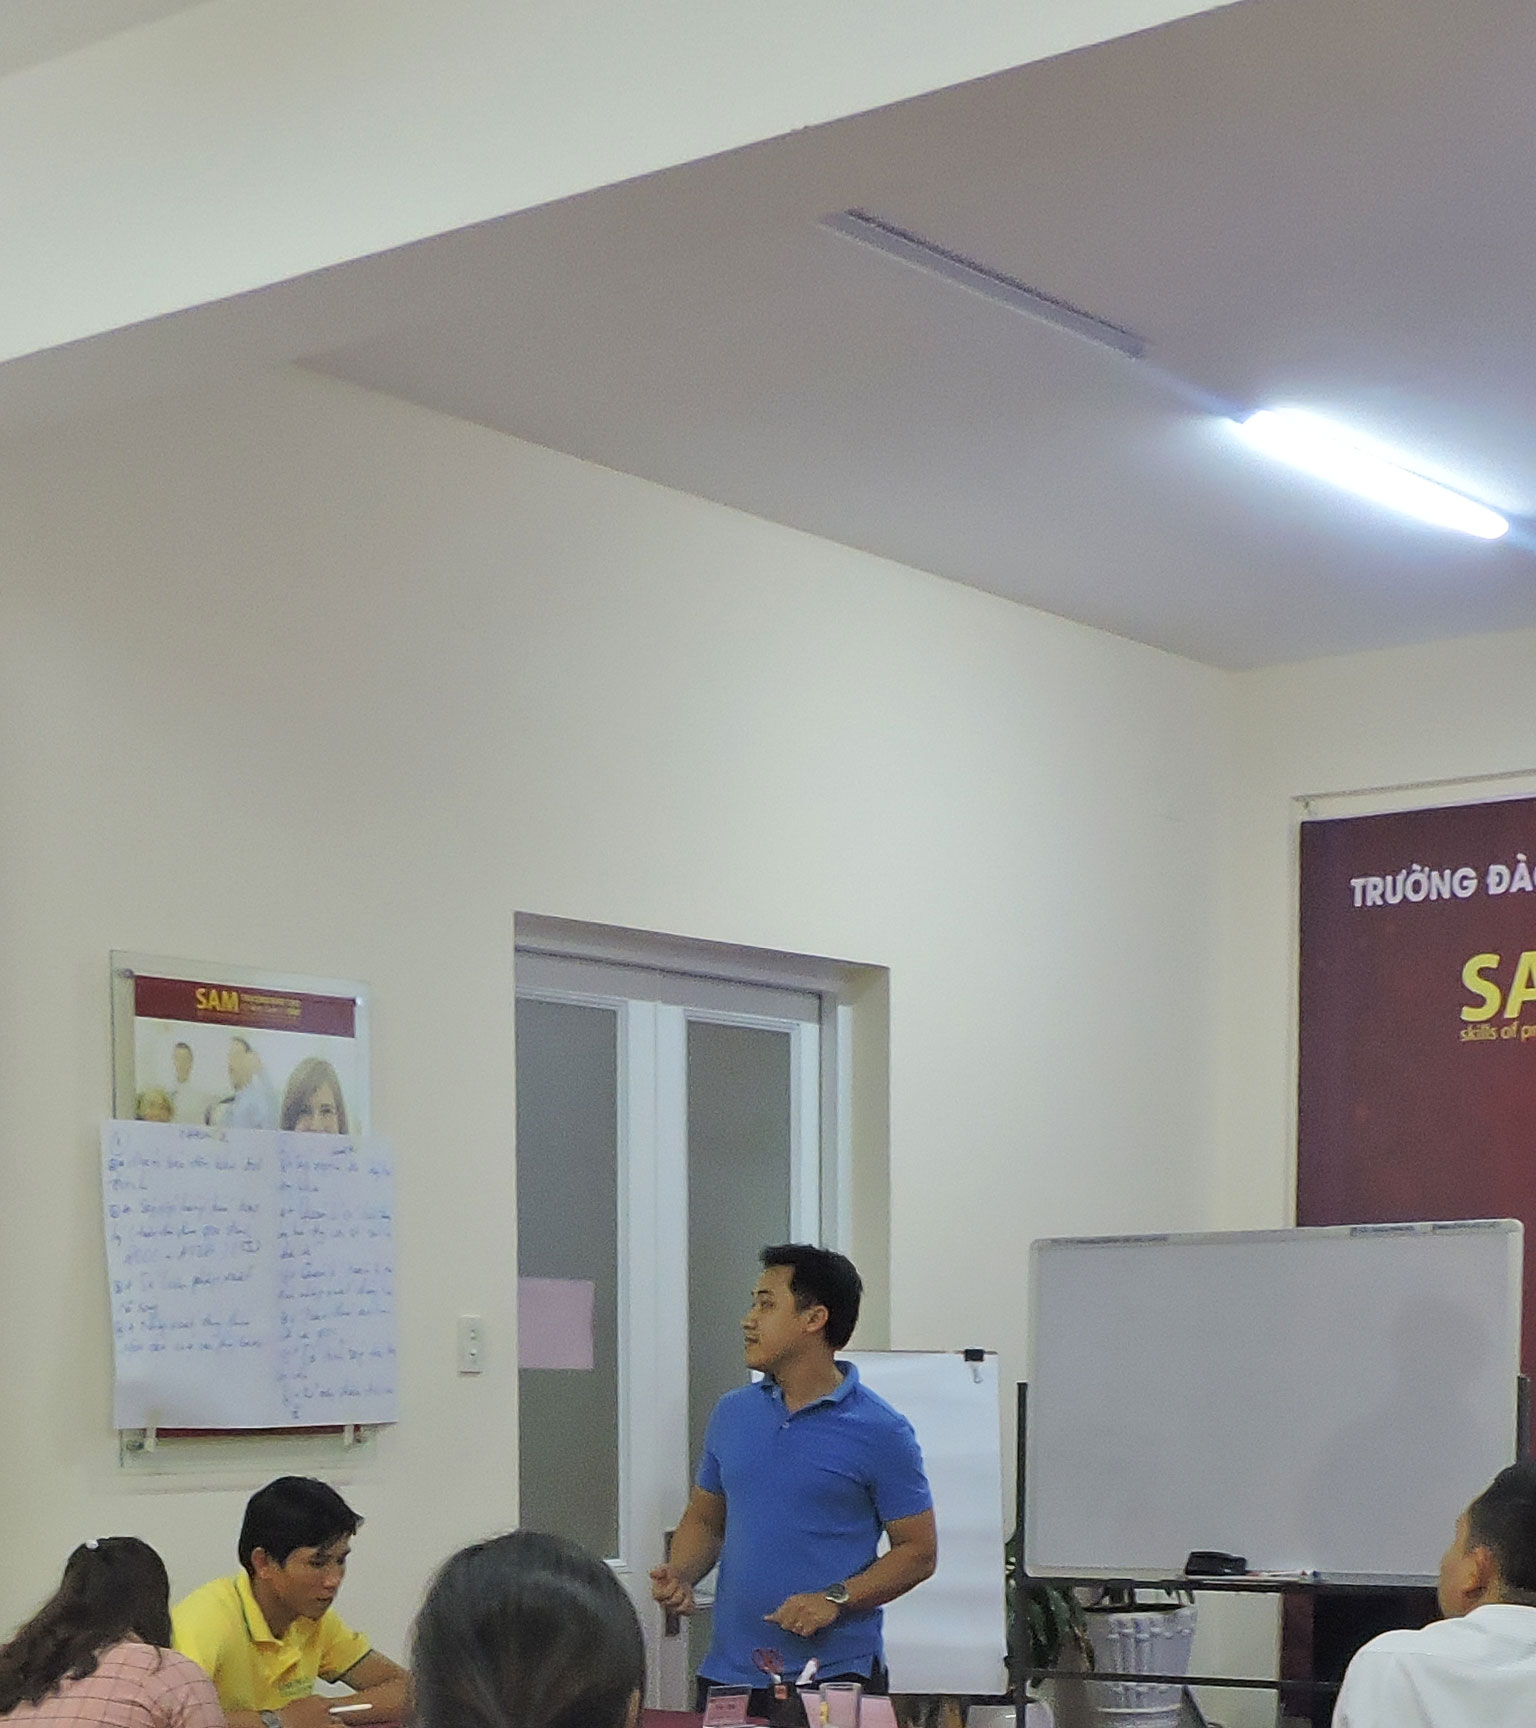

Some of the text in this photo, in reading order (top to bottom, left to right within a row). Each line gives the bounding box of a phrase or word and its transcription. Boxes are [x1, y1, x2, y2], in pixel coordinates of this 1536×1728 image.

[1350, 863, 1478, 907] TRƯỜNG
[195, 987, 239, 1013] SAM
[1460, 1023, 1497, 1042] skills
[1500, 1021, 1519, 1040] of
